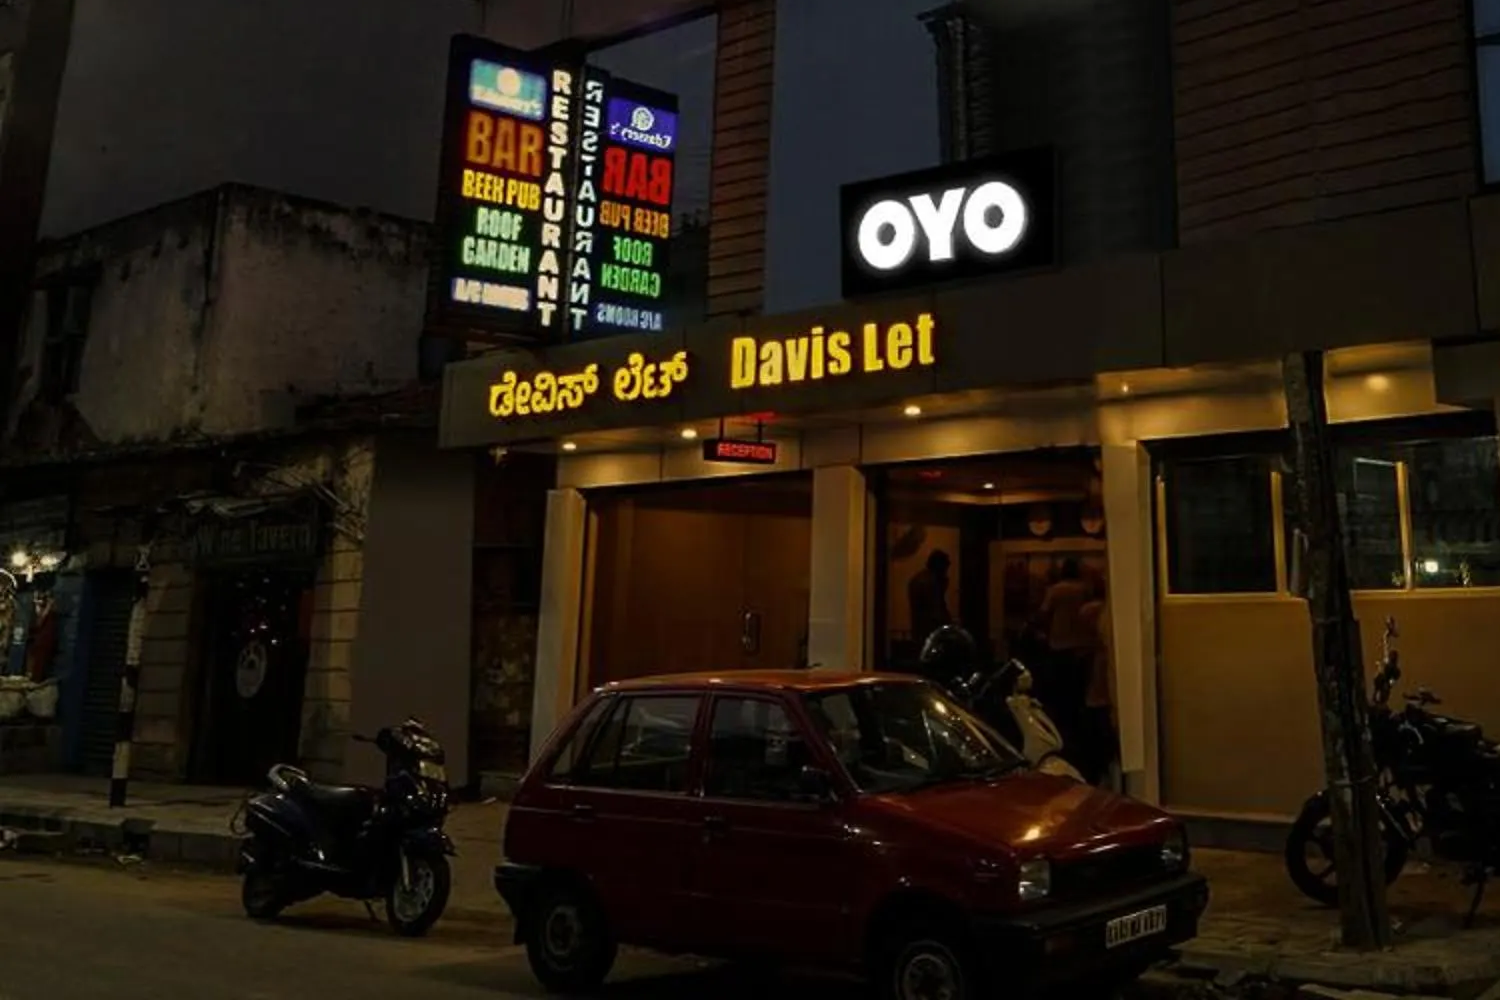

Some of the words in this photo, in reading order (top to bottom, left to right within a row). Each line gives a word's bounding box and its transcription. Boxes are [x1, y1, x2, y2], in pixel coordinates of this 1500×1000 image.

[466, 110, 544, 177] BAR
[462, 169, 505, 204] BEER
[505, 178, 542, 210] PUB
[537, 70, 572, 326] RESTAURANT
[476, 207, 524, 241] ROOF
[857, 181, 1027, 270] OYO
[462, 236, 531, 274] GARDEN
[731, 326, 851, 388] Davis
[863, 313, 935, 372] Let
[489, 363, 599, 417] ಡೇವಿಸ್
[717, 441, 774, 460] RECEPTION
